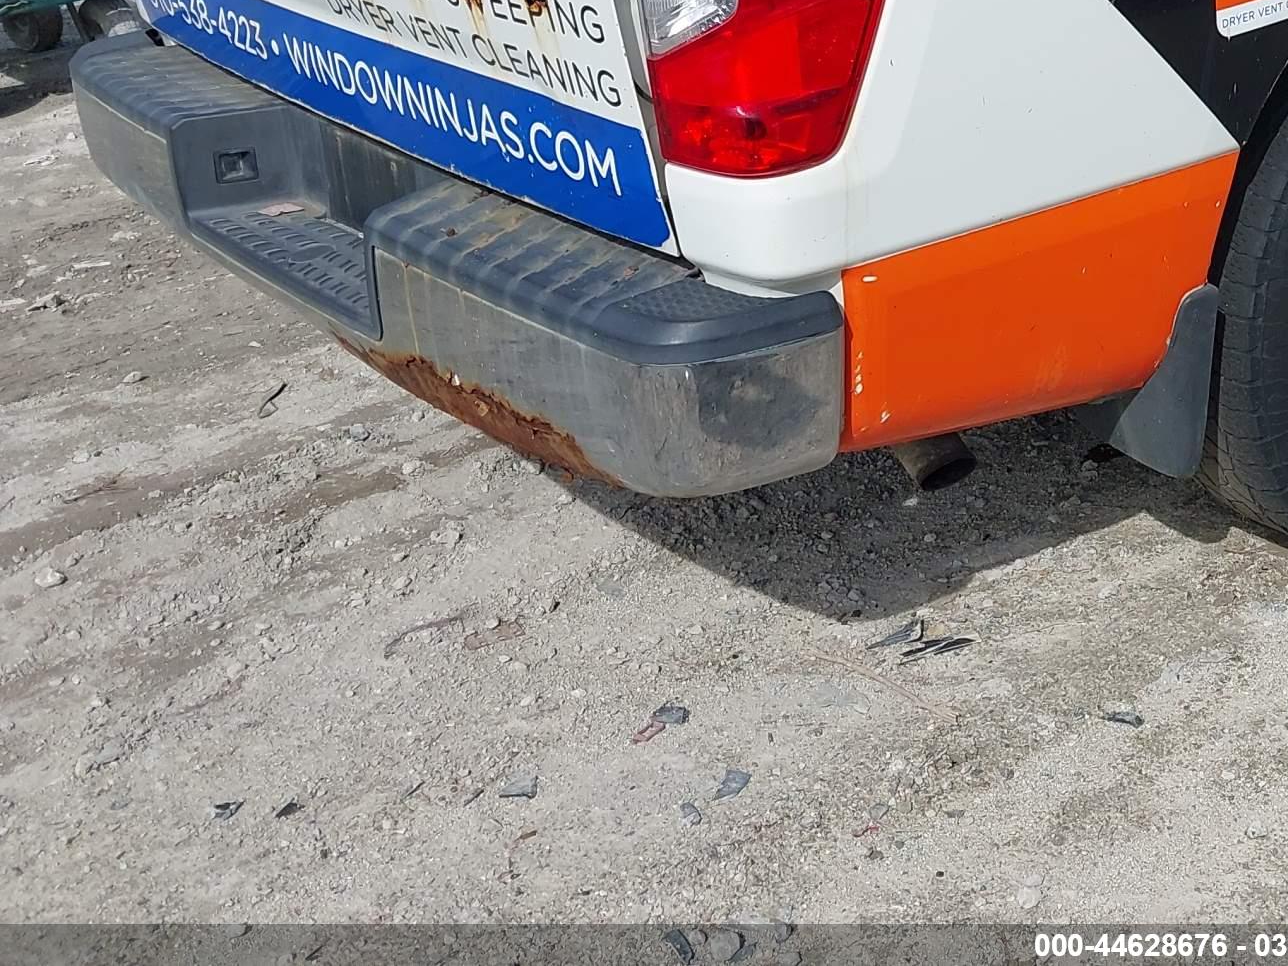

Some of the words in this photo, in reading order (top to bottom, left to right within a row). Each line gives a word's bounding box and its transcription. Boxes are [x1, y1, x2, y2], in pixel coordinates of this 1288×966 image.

[400, 10, 468, 59] VENT
[472, 34, 622, 108] CLEANING
[1222, 11, 1255, 29] DRYER
[1258, 2, 1284, 19] VENT
[283, 33, 622, 197] WINDOWNINJAS.COM
